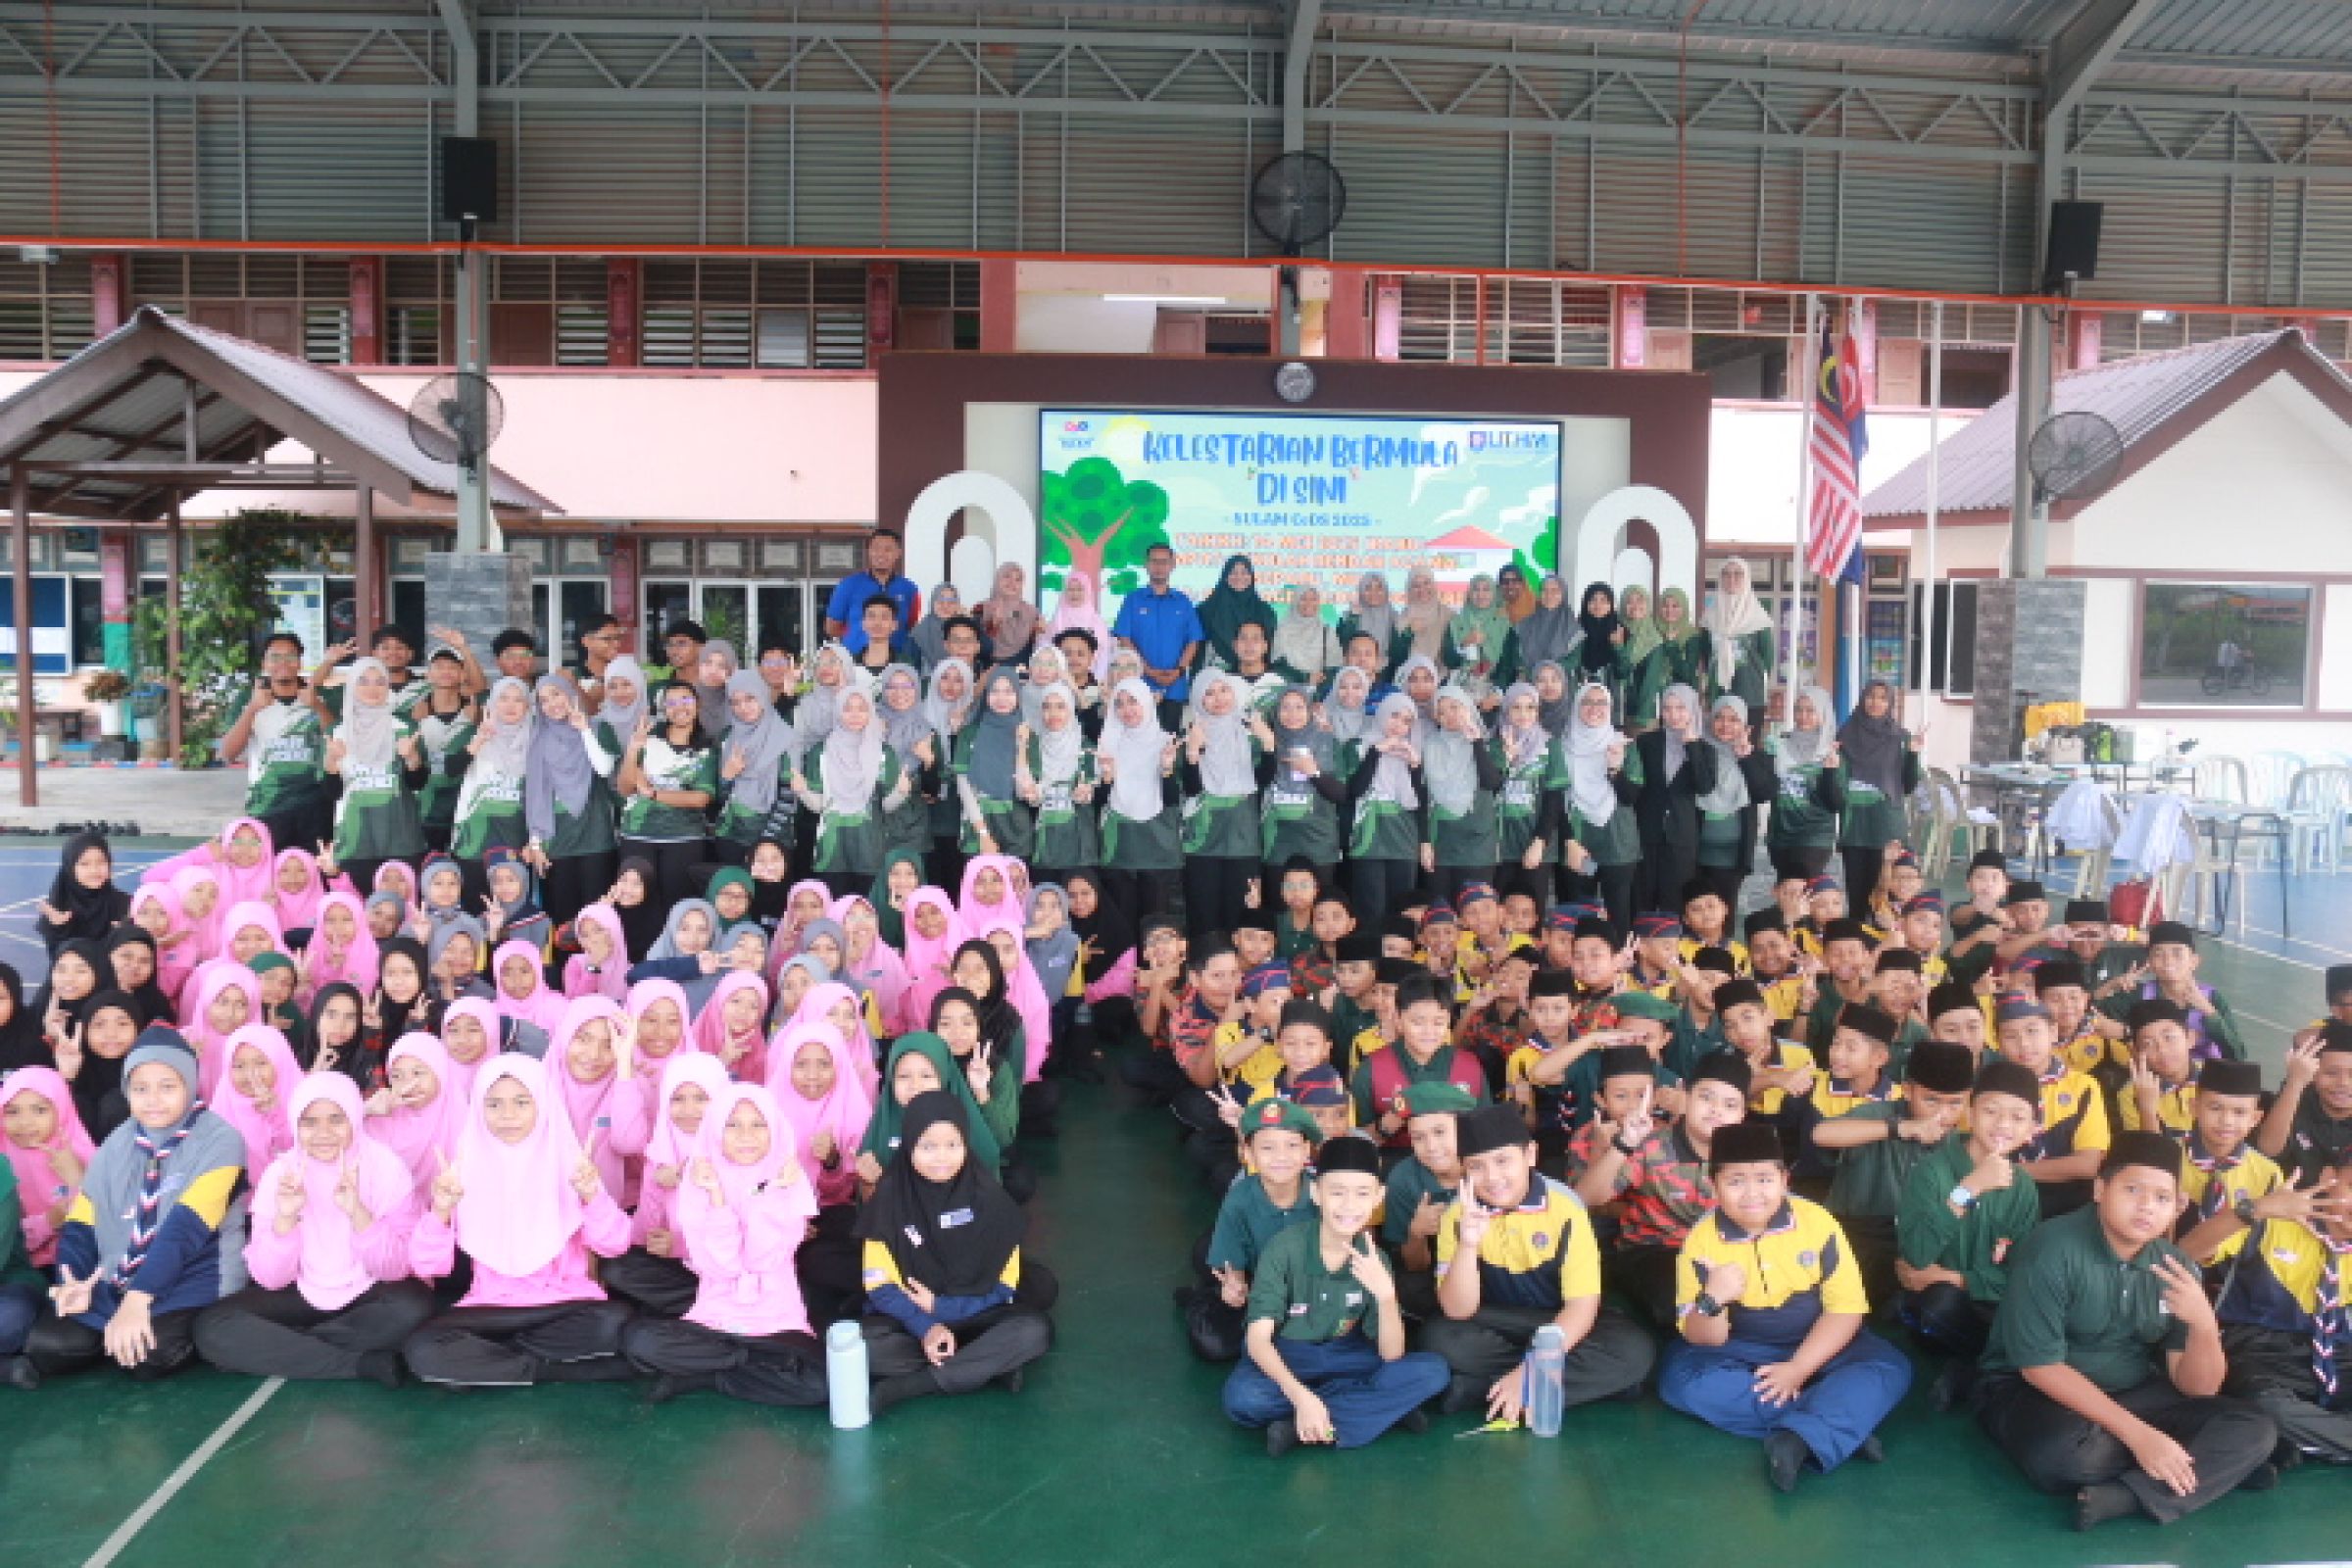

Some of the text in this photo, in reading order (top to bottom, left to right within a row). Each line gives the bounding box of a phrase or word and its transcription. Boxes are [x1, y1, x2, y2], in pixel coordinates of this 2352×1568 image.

[1143, 431, 1458, 469] KELESTARIAN BERMULA
[1257, 473, 1347, 505] DI SINI
